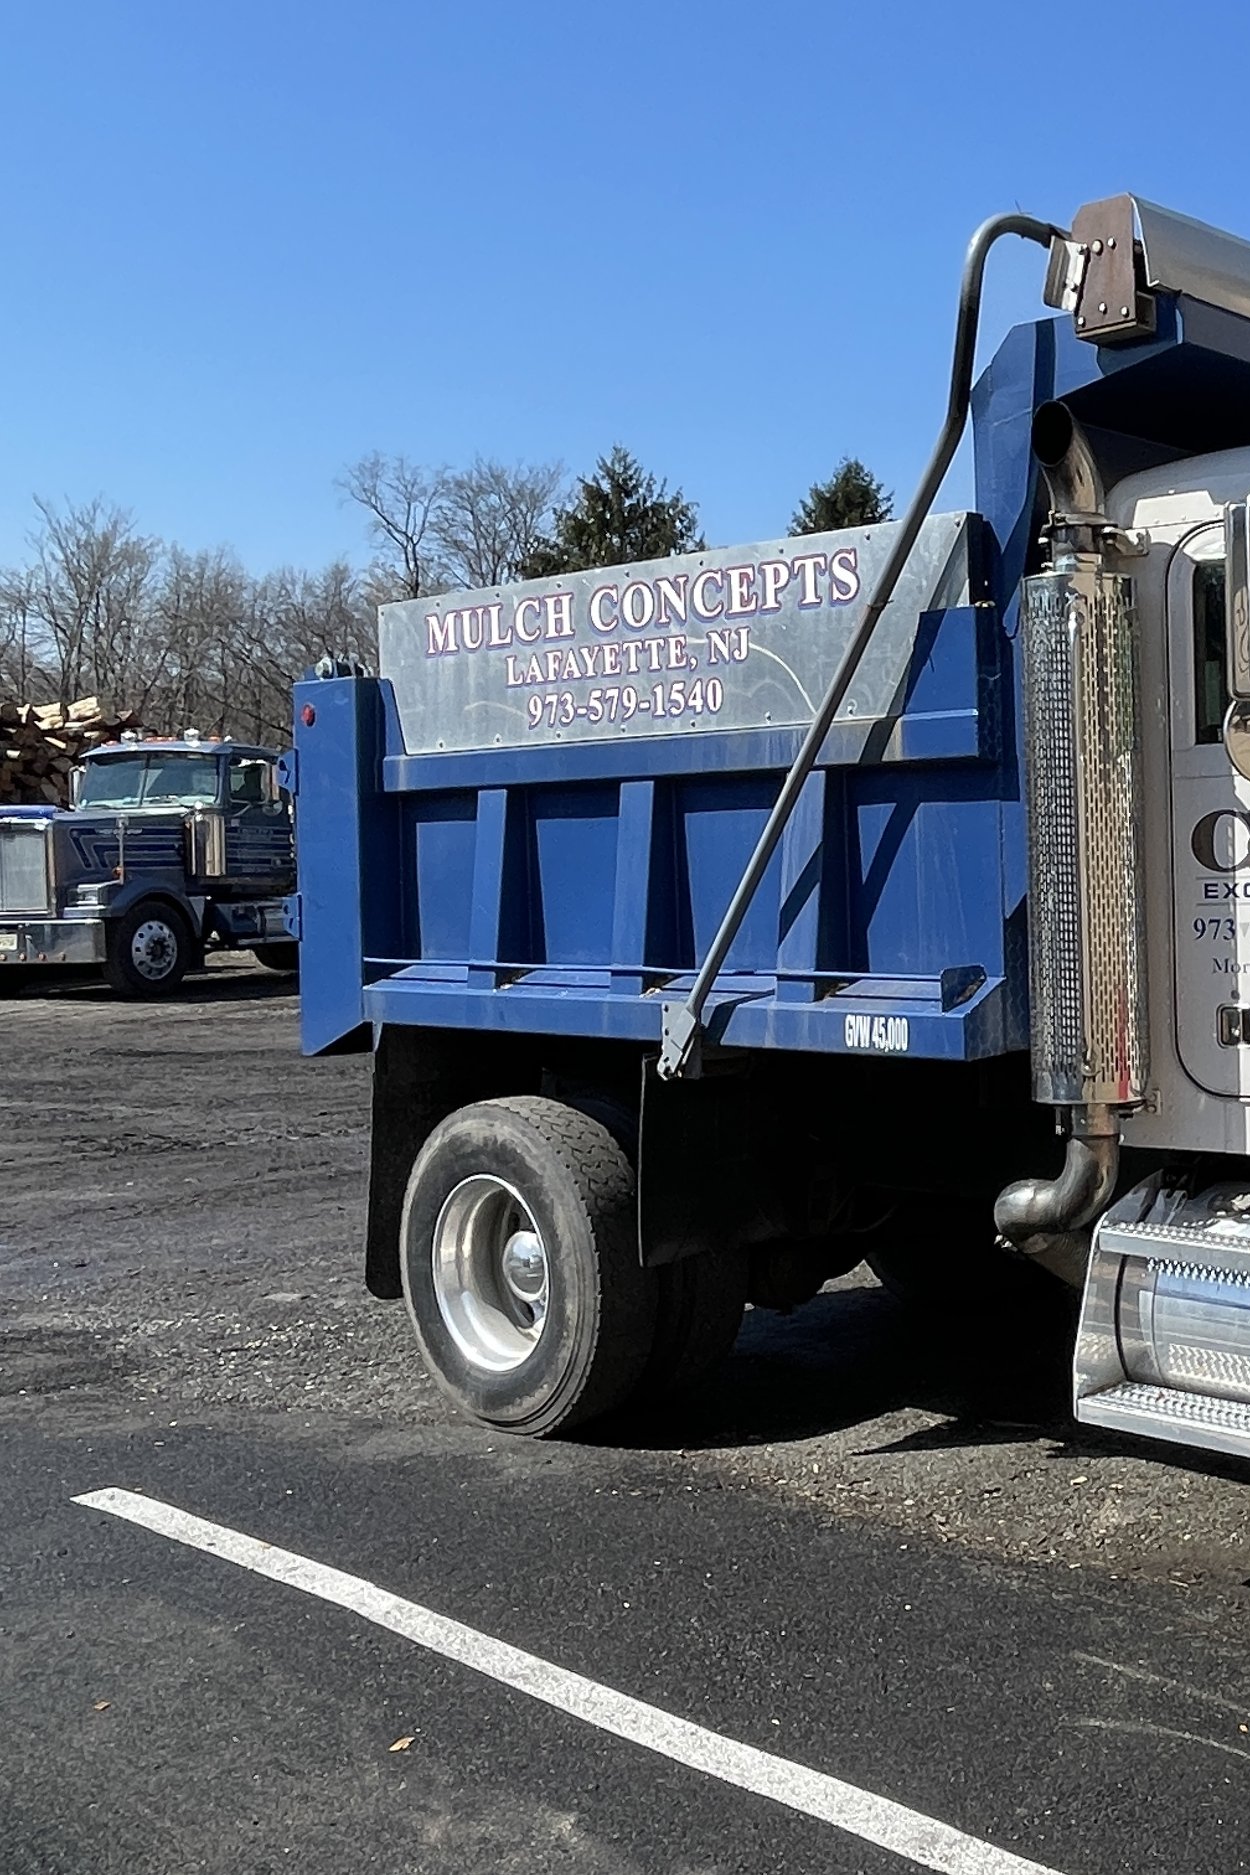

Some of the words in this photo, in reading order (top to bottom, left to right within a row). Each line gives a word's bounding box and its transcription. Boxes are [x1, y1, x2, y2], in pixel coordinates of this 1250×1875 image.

[425, 592, 575, 657] MULCH
[589, 547, 862, 634] CONCEPTS
[505, 635, 698, 689] LAFAYETTE,
[708, 626, 751, 664] NJ
[527, 677, 726, 730] 973-579-1540
[1192, 916, 1237, 942] 973
[844, 1014, 871, 1048] GVW
[871, 1016, 909, 1053] 45,000
